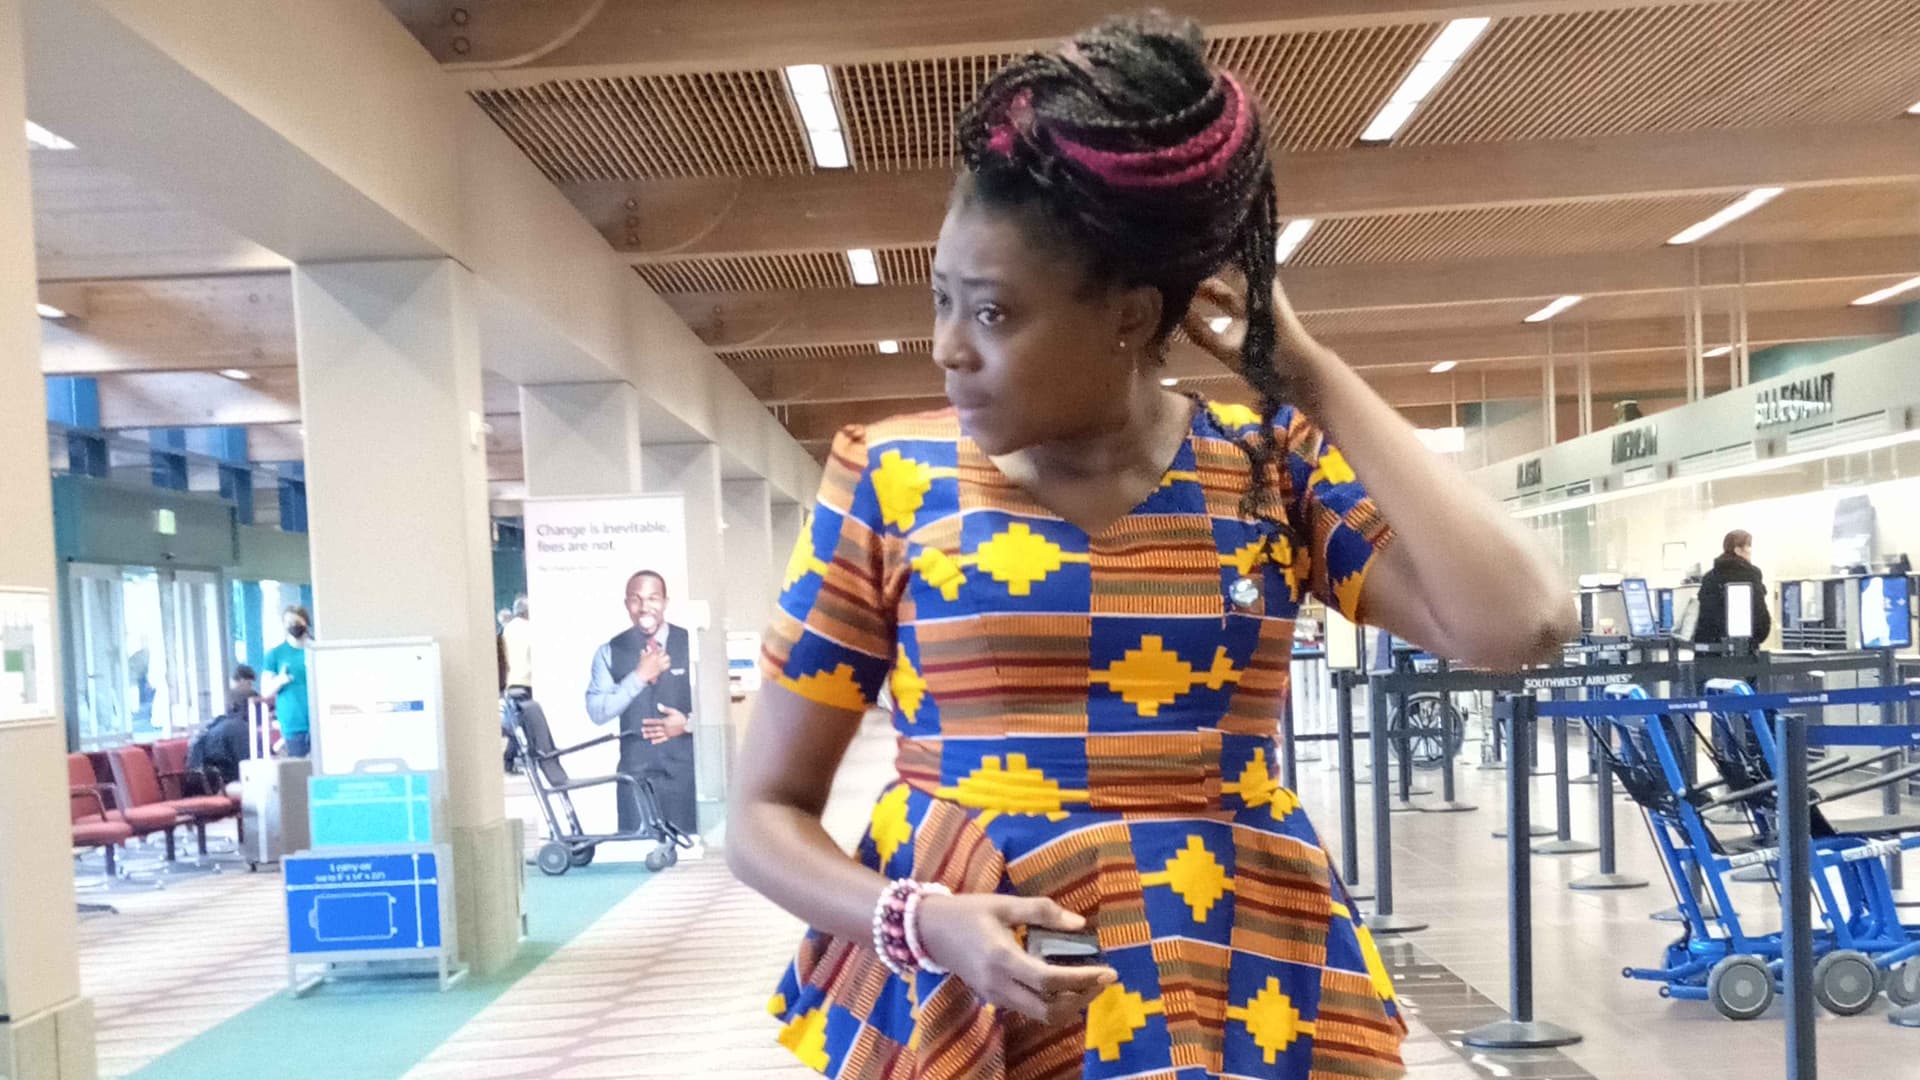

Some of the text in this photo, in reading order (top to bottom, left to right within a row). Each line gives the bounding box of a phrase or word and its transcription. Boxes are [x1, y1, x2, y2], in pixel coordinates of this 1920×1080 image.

[536, 523, 586, 538] Change
[590, 522, 600, 535] is
[568, 541, 588, 552] are
[1524, 676, 1583, 689] SOUTHWEST
